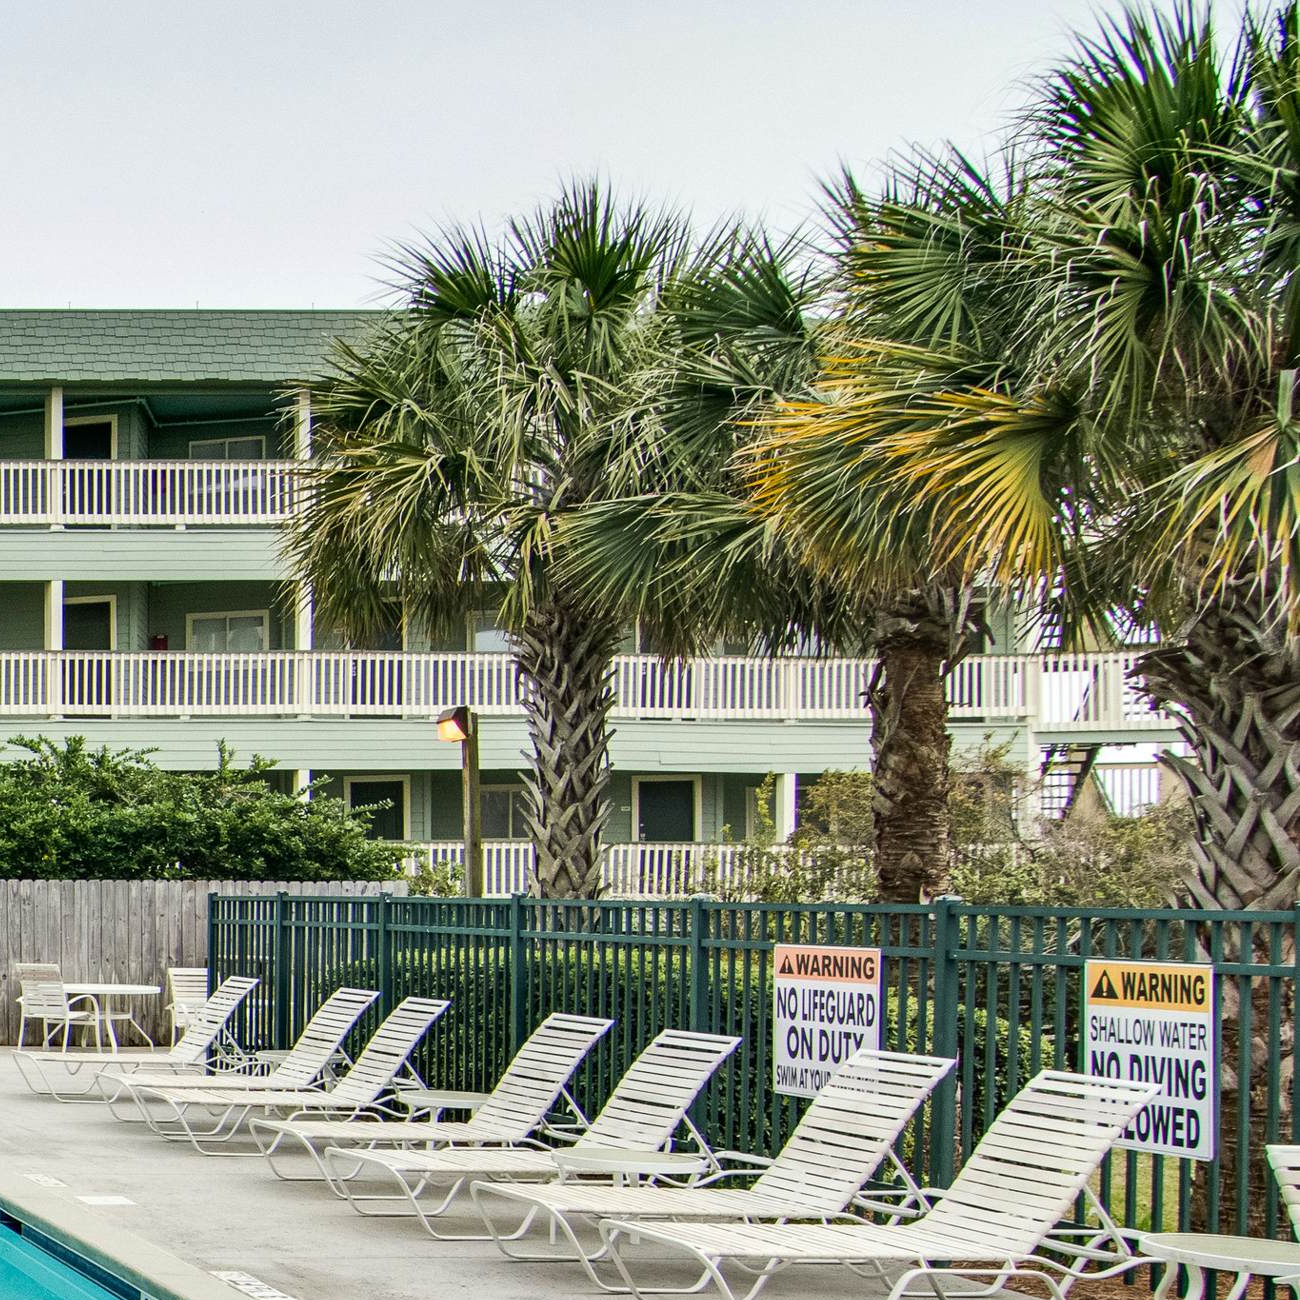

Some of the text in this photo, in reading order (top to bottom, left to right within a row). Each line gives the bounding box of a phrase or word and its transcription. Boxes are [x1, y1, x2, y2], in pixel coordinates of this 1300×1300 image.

[796, 954, 875, 980] WARNING
[777, 986, 875, 1027] NO LIFEGUARD
[1121, 971, 1205, 1005] WARNING
[787, 1025, 865, 1064] ON DUTY
[1090, 1015, 1207, 1051] SHALLOW WATER
[776, 1064, 798, 1087] SWIM
[799, 1068, 809, 1087] AT
[1091, 1050, 1206, 1101] NO DIVING
[1120, 1104, 1200, 1149] OWED
